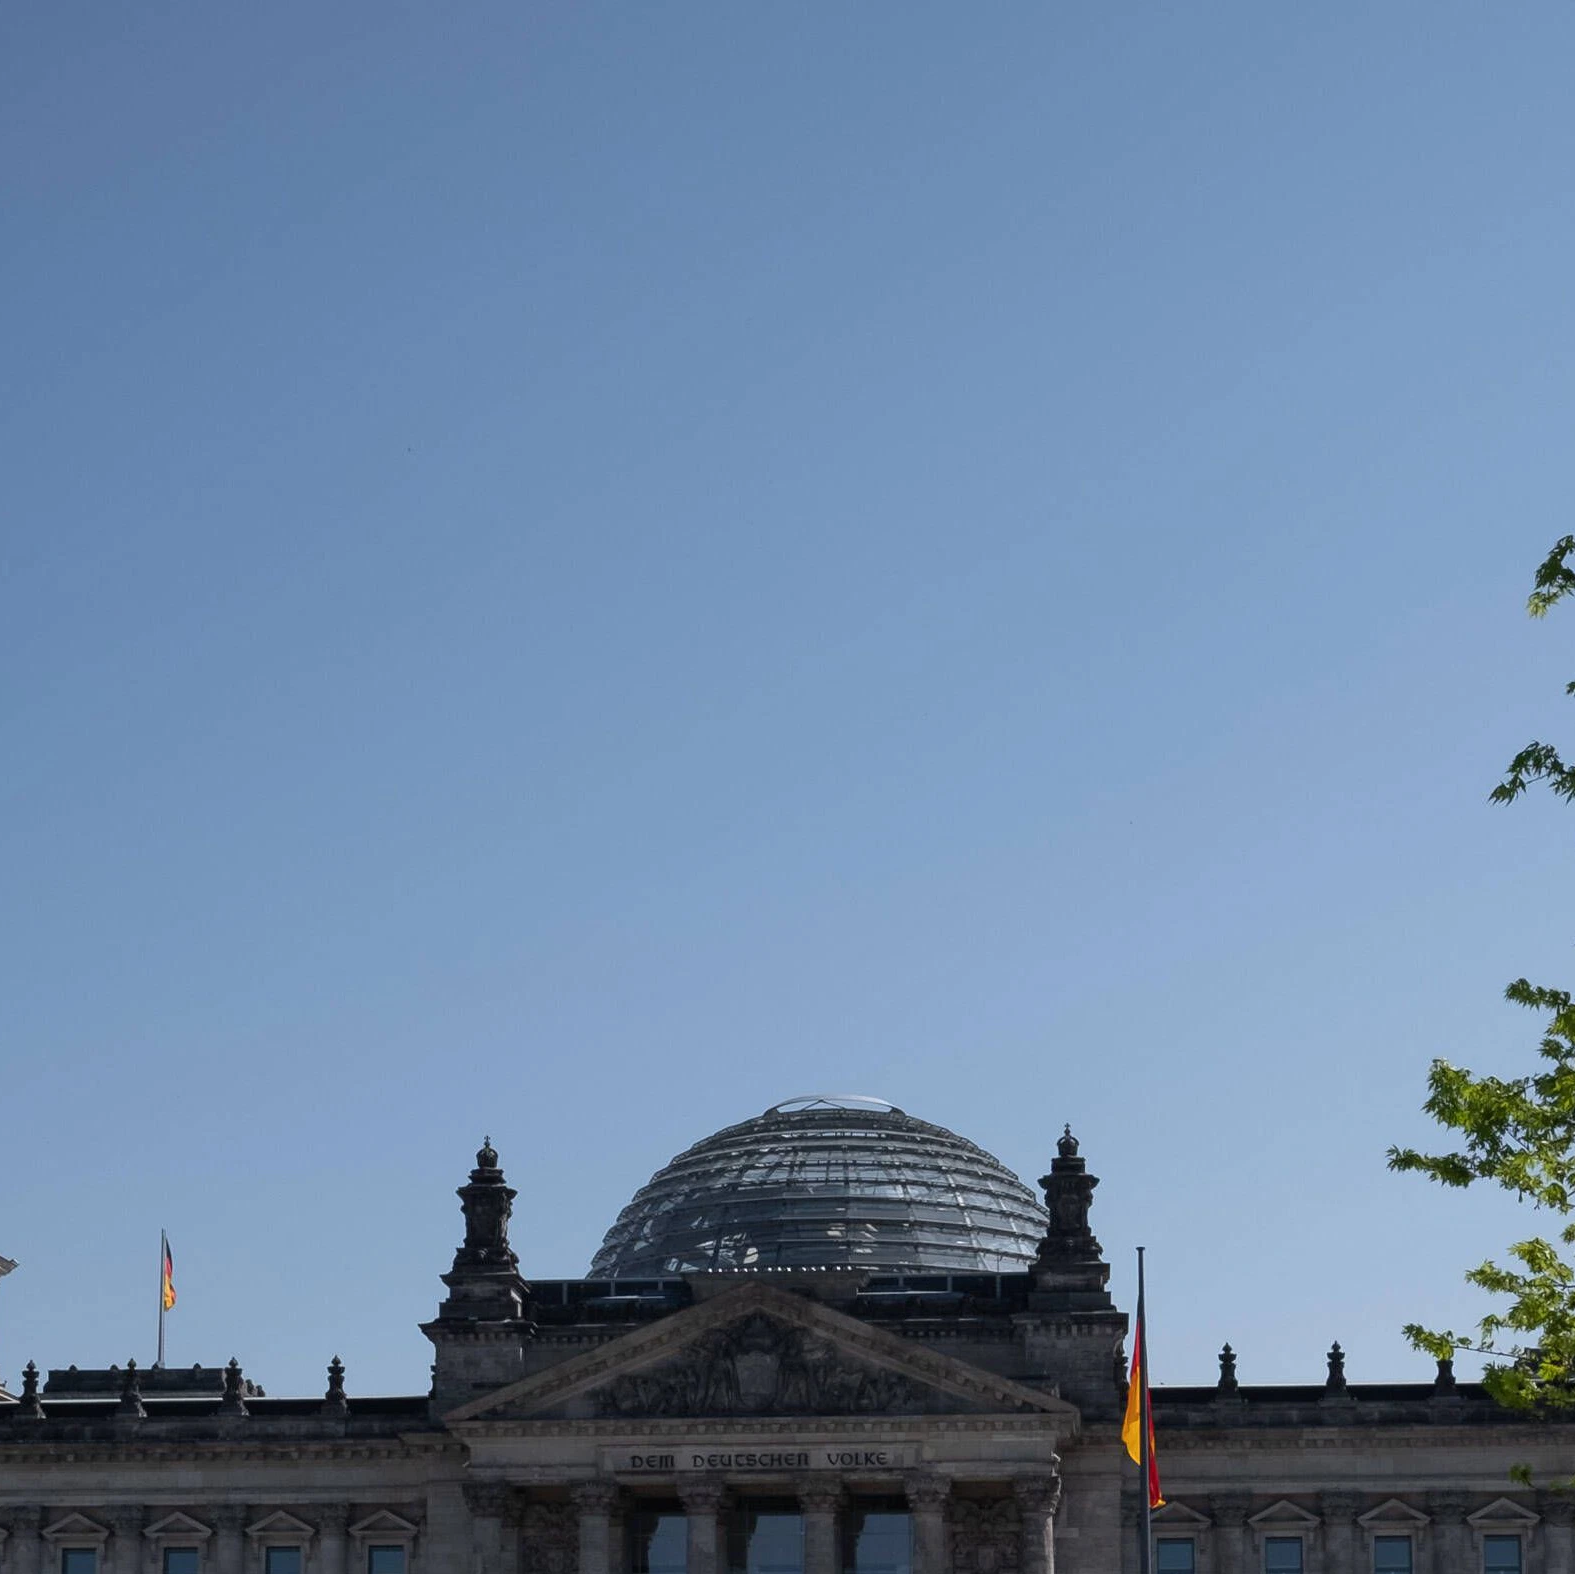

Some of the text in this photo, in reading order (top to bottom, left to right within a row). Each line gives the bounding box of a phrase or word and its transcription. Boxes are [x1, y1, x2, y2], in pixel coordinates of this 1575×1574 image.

[630, 1451, 889, 1469] DEM DEUTSCHEN VOLKE
